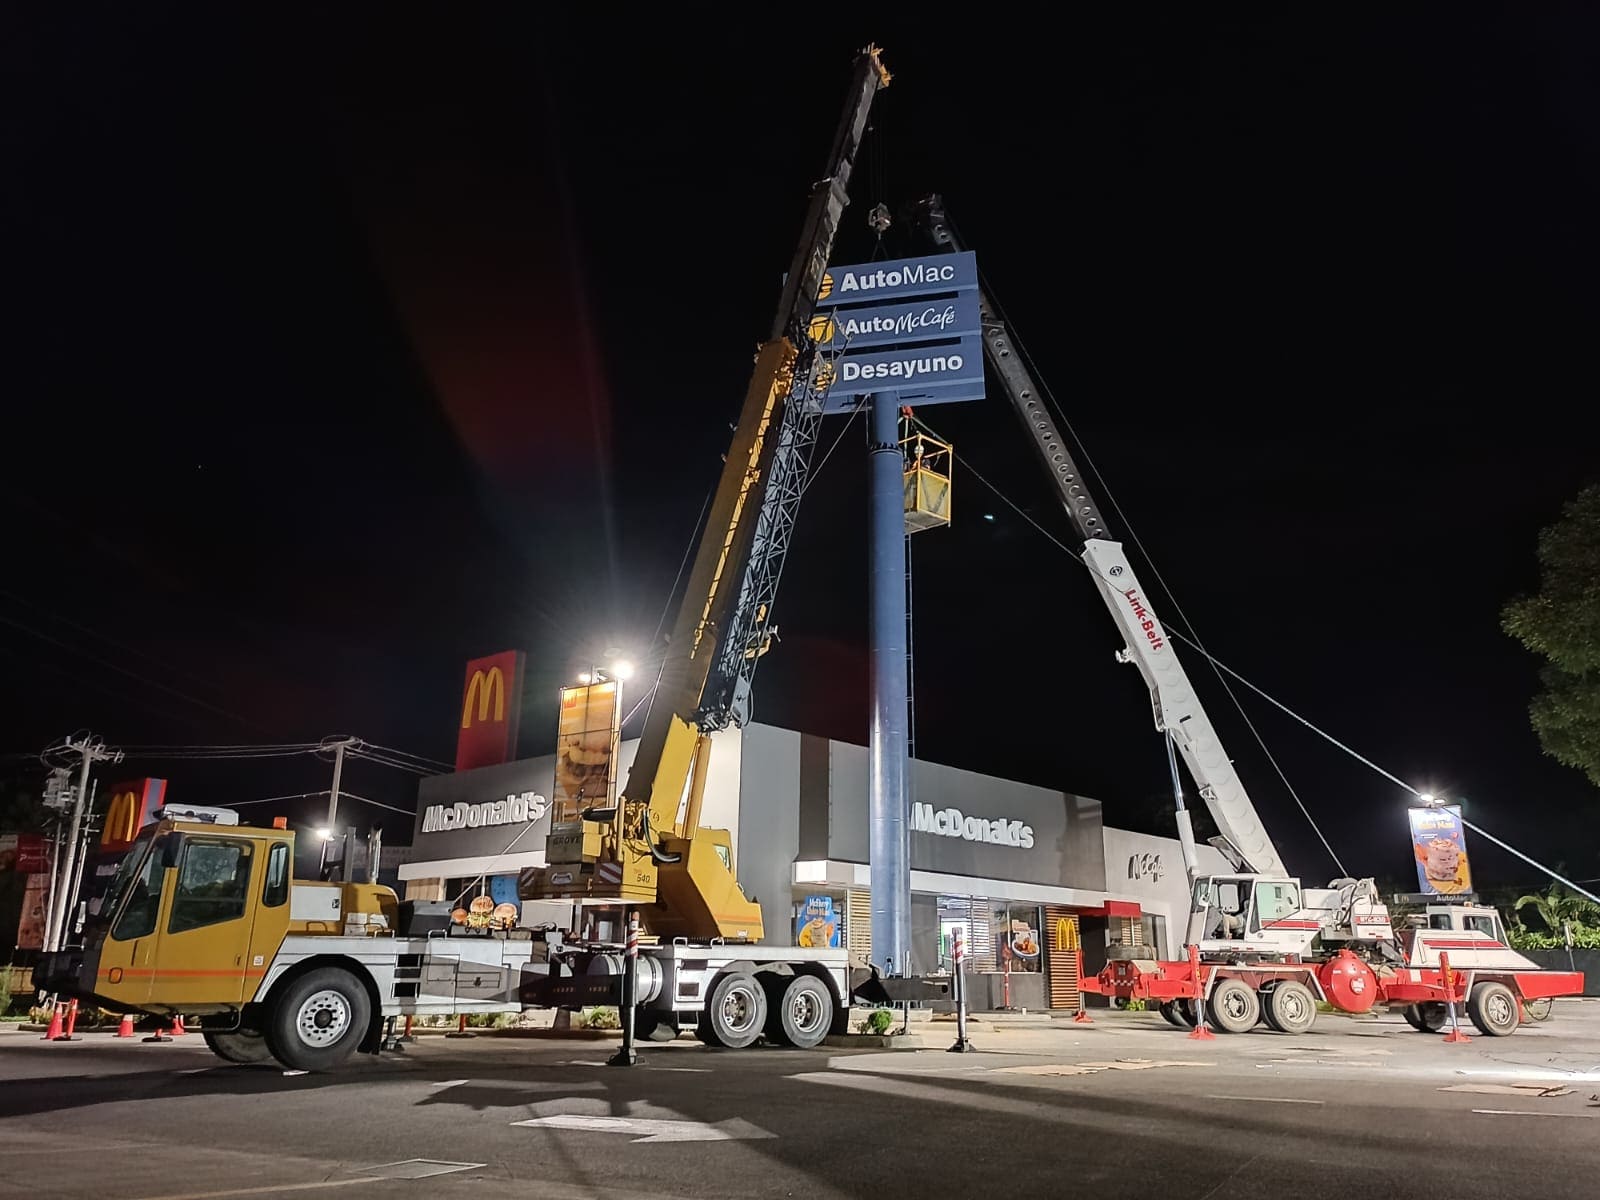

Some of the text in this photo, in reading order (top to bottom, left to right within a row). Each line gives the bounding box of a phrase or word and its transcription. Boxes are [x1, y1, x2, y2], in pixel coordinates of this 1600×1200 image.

[840, 264, 955, 293] AutoMac
[843, 355, 963, 381] Desayuno
[1124, 588, 1164, 651] Link-Belt
[421, 791, 546, 833] McDonald's
[910, 801, 1034, 849] McDonald's
